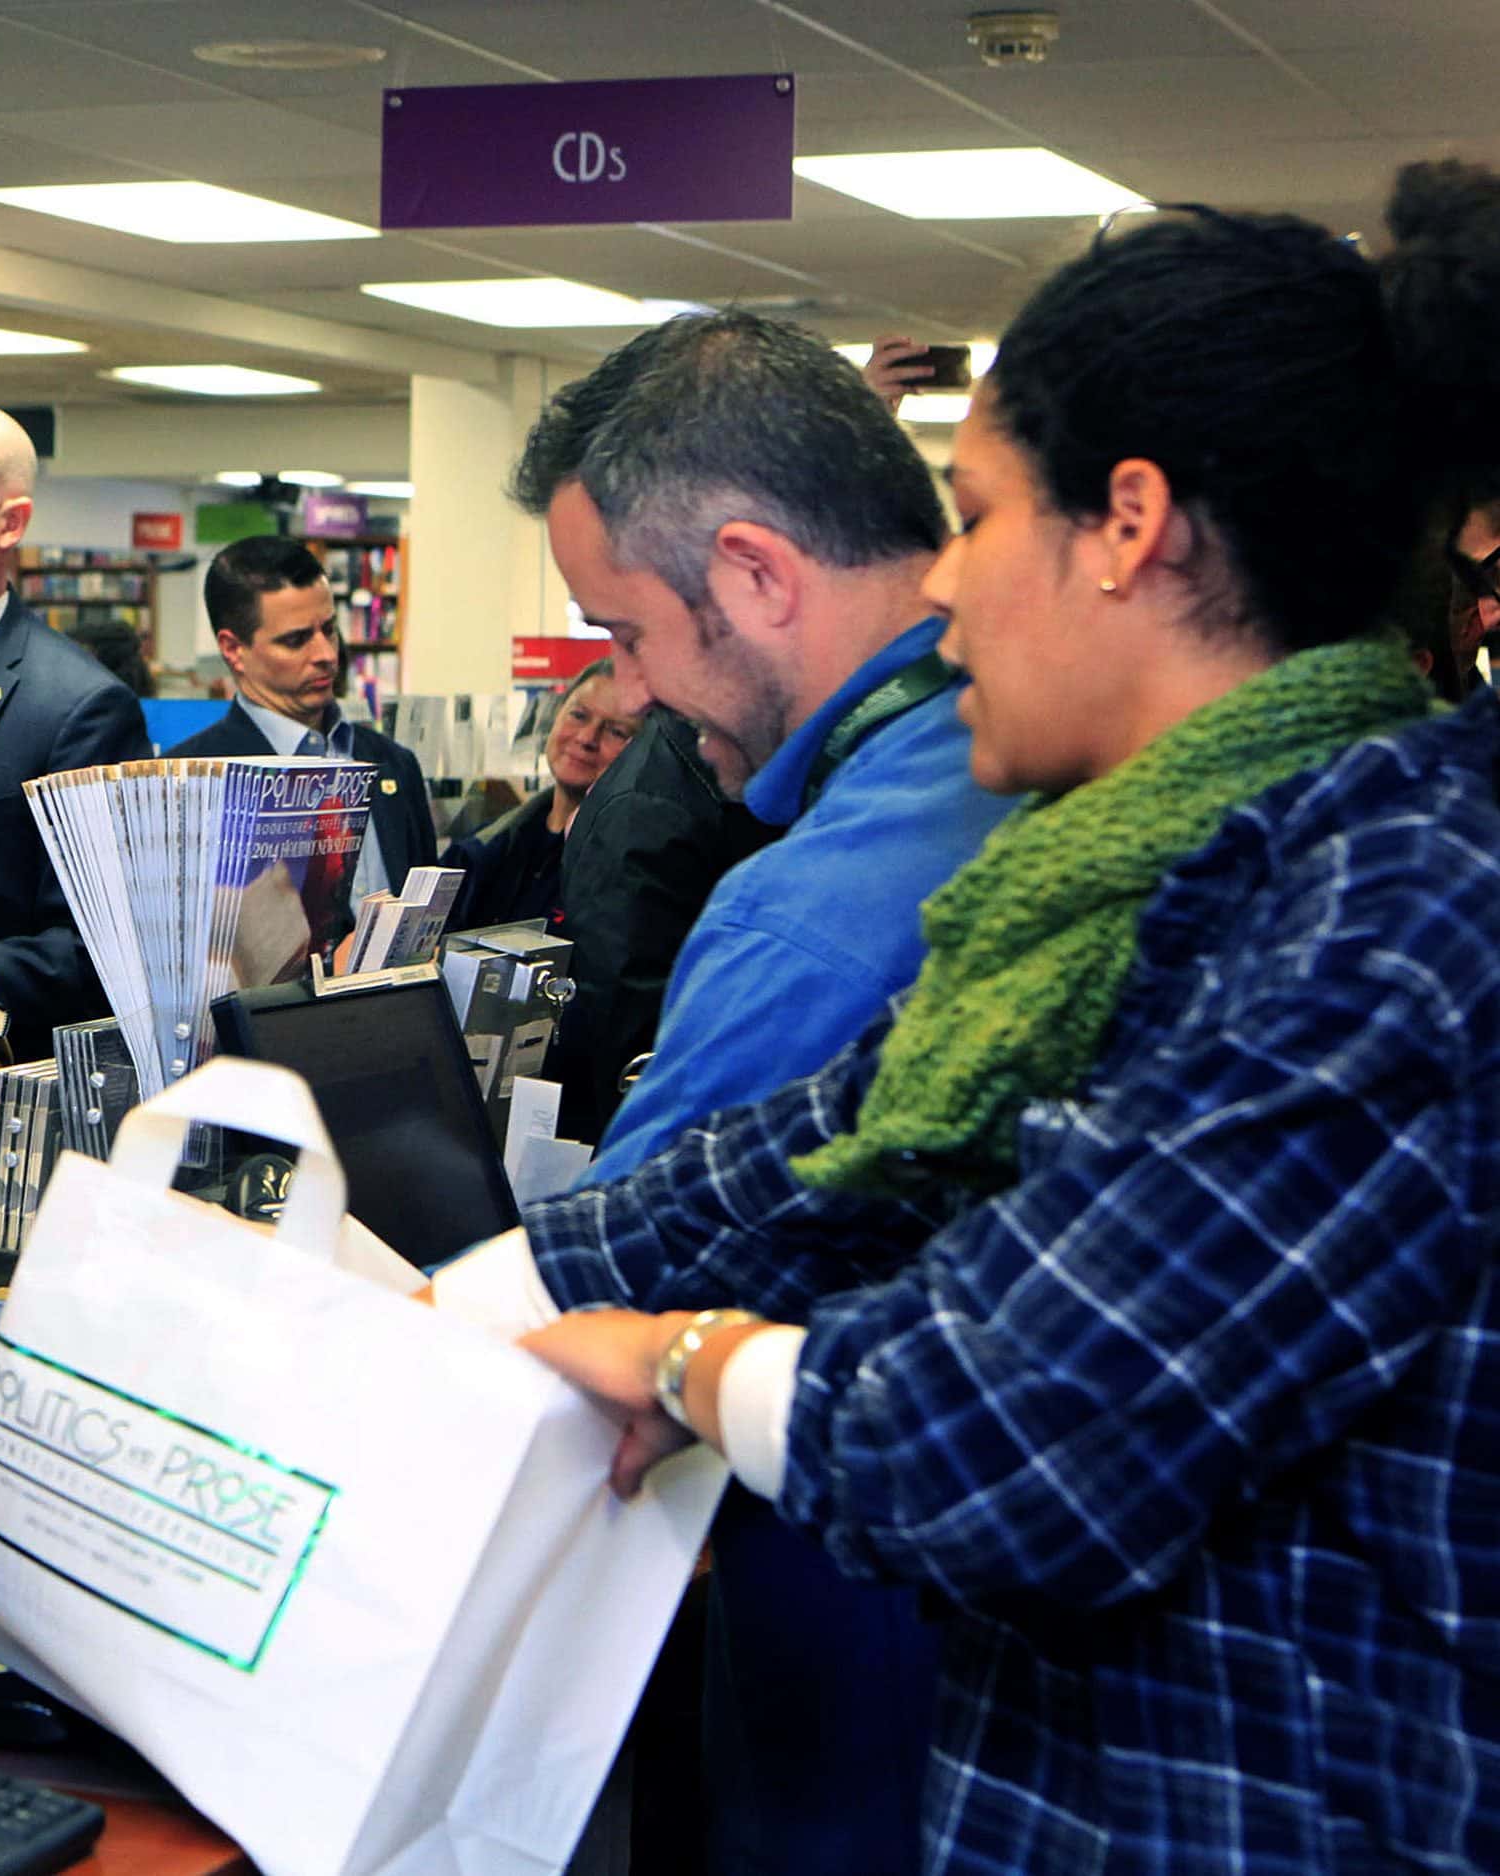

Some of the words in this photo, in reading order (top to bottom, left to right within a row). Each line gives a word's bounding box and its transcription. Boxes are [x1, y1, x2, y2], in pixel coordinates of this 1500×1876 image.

[552, 131, 627, 182] CDs
[259, 773, 327, 809] POLITICS
[251, 842, 280, 861] 2014
[155, 1444, 298, 1544] PROSE
